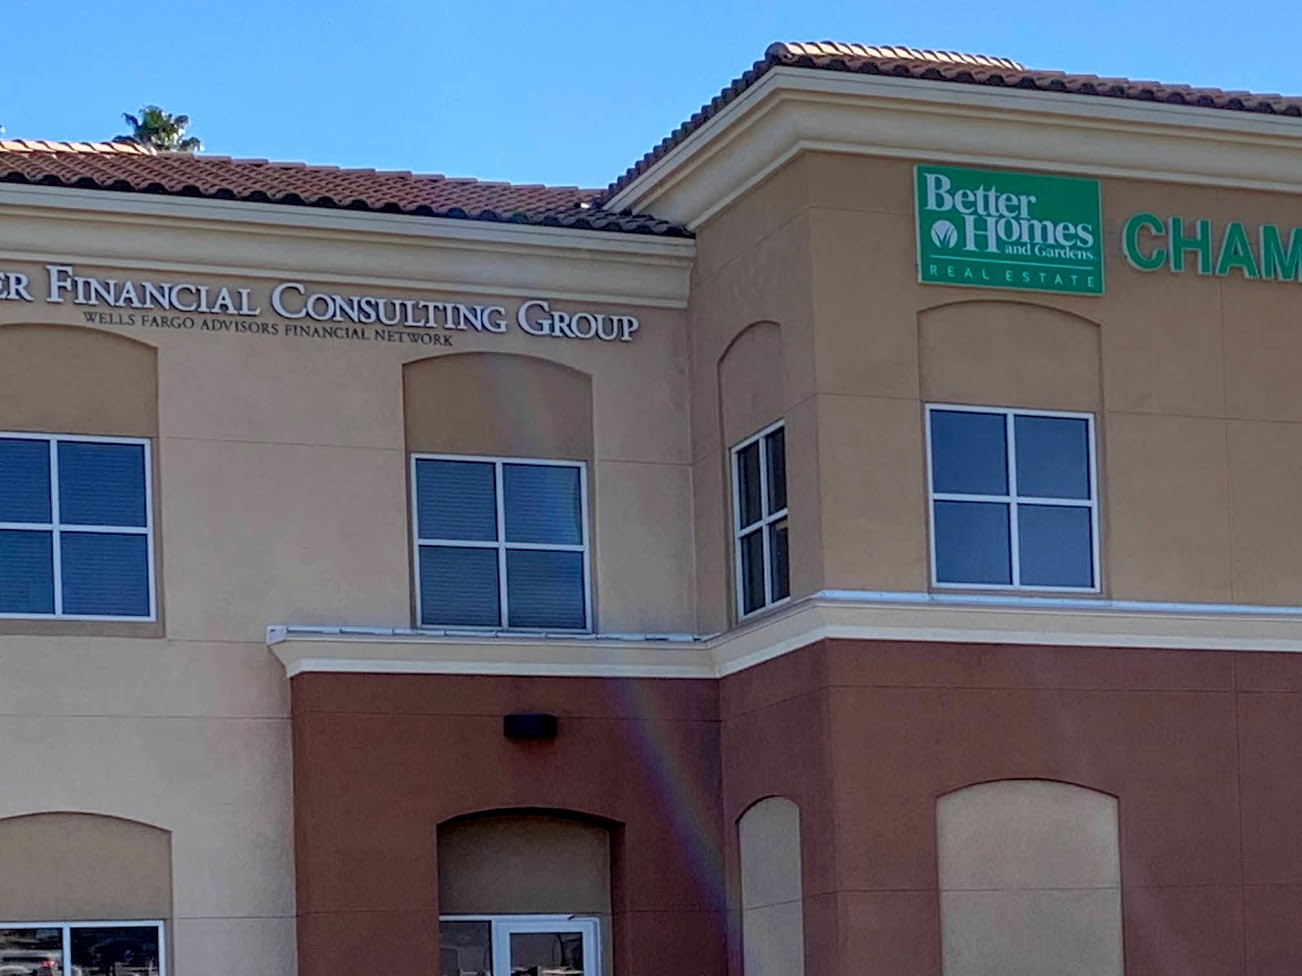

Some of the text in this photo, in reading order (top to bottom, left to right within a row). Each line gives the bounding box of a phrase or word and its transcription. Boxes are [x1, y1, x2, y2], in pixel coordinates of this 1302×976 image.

[923, 173, 1037, 218] Better
[962, 215, 1094, 254] Homes
[1005, 244, 1094, 260] and Gardens
[929, 265, 1095, 287] REAL ESTATE
[83, 311, 454, 347] WELLS FARGO ADVISORS FINANCIAL NETWORK
